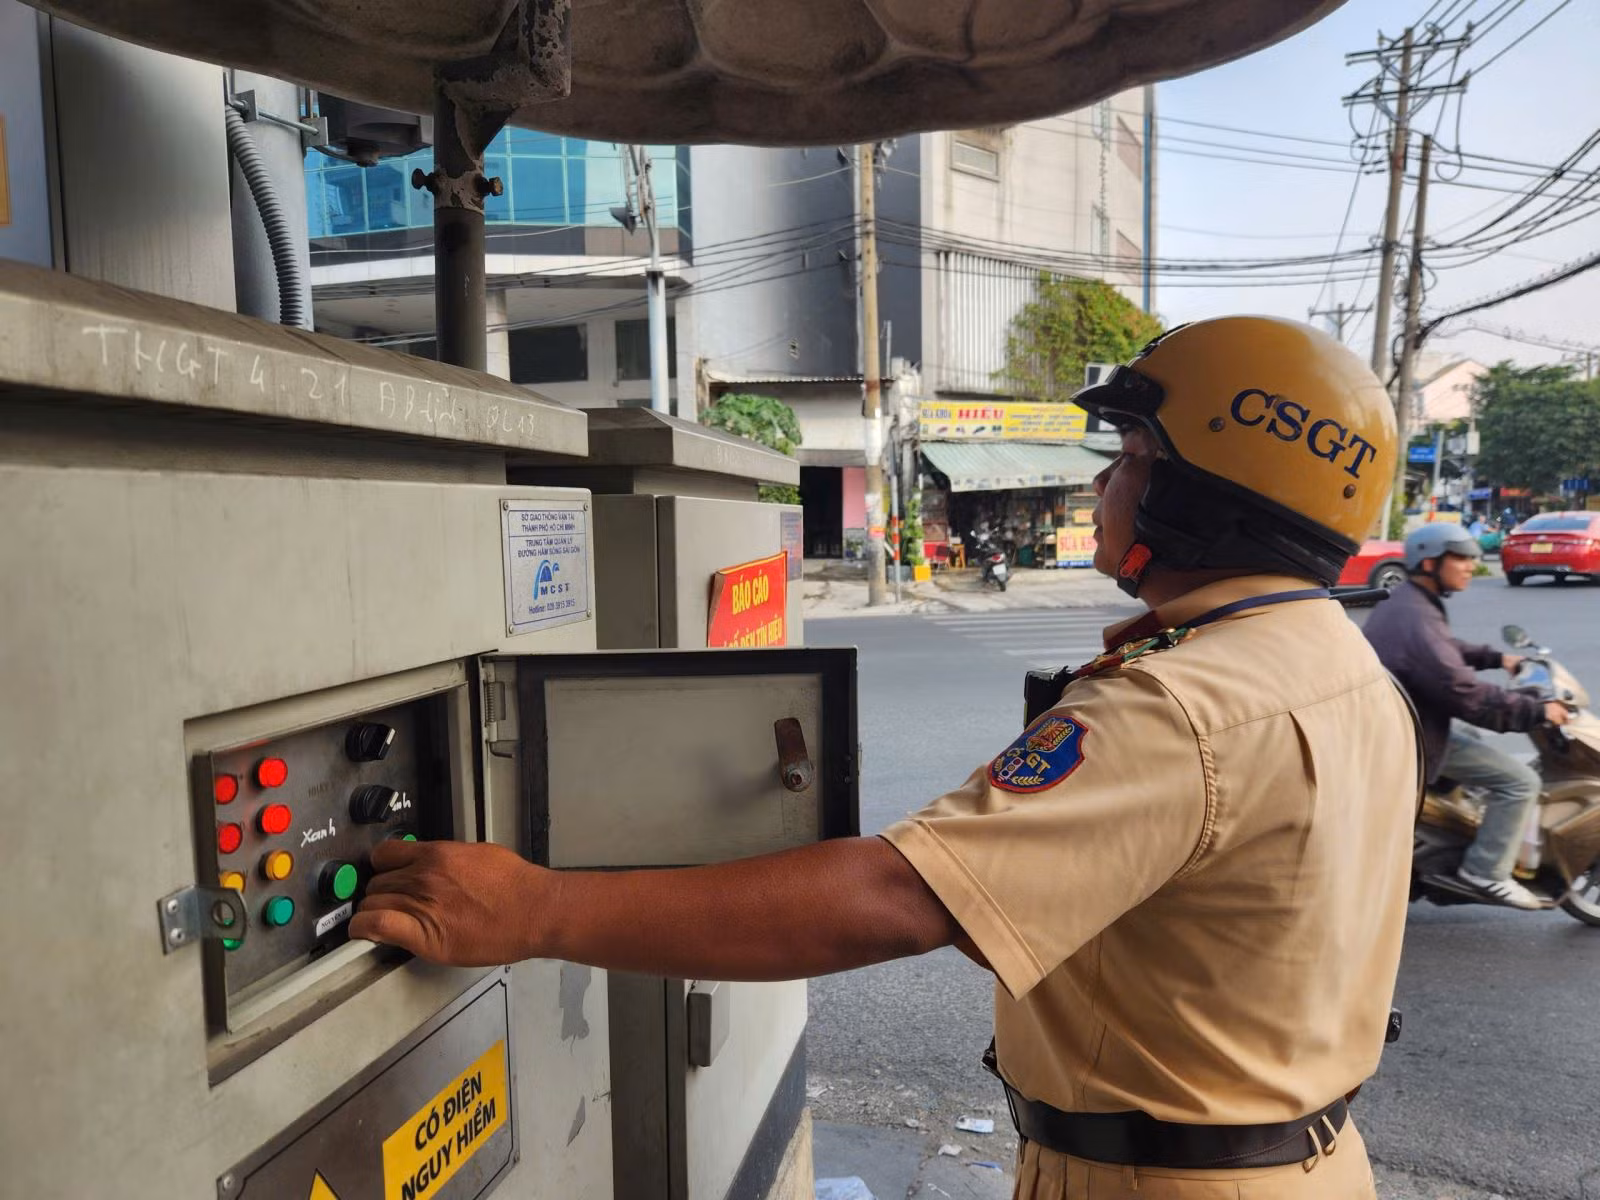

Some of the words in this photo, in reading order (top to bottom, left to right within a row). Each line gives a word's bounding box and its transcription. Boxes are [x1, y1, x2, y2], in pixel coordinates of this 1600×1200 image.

[1230, 388, 1377, 479] CSGT
[521, 522, 538, 533] THÀNH
[539, 521, 549, 532] PHỐ
[564, 522, 576, 531] MINH
[530, 513, 541, 521] GIAO
[542, 511, 558, 521] THÔNG
[517, 547, 537, 558] ĐƯỜNG
[549, 546, 562, 555] SÔNG
[525, 539, 543, 547] TRUNG
[543, 537, 553, 546] TÂM
[554, 536, 567, 545] QUẢN
[732, 574, 751, 616] BÁO
[752, 569, 769, 606] CÁO
[768, 613, 783, 645] HIỆU
[300, 817, 336, 849] Xanh
[414, 1104, 440, 1151] CÓ
[443, 1071, 483, 1127] ĐIỆN
[401, 1136, 453, 1200] NGUY
[456, 1096, 496, 1154] HIỂM
